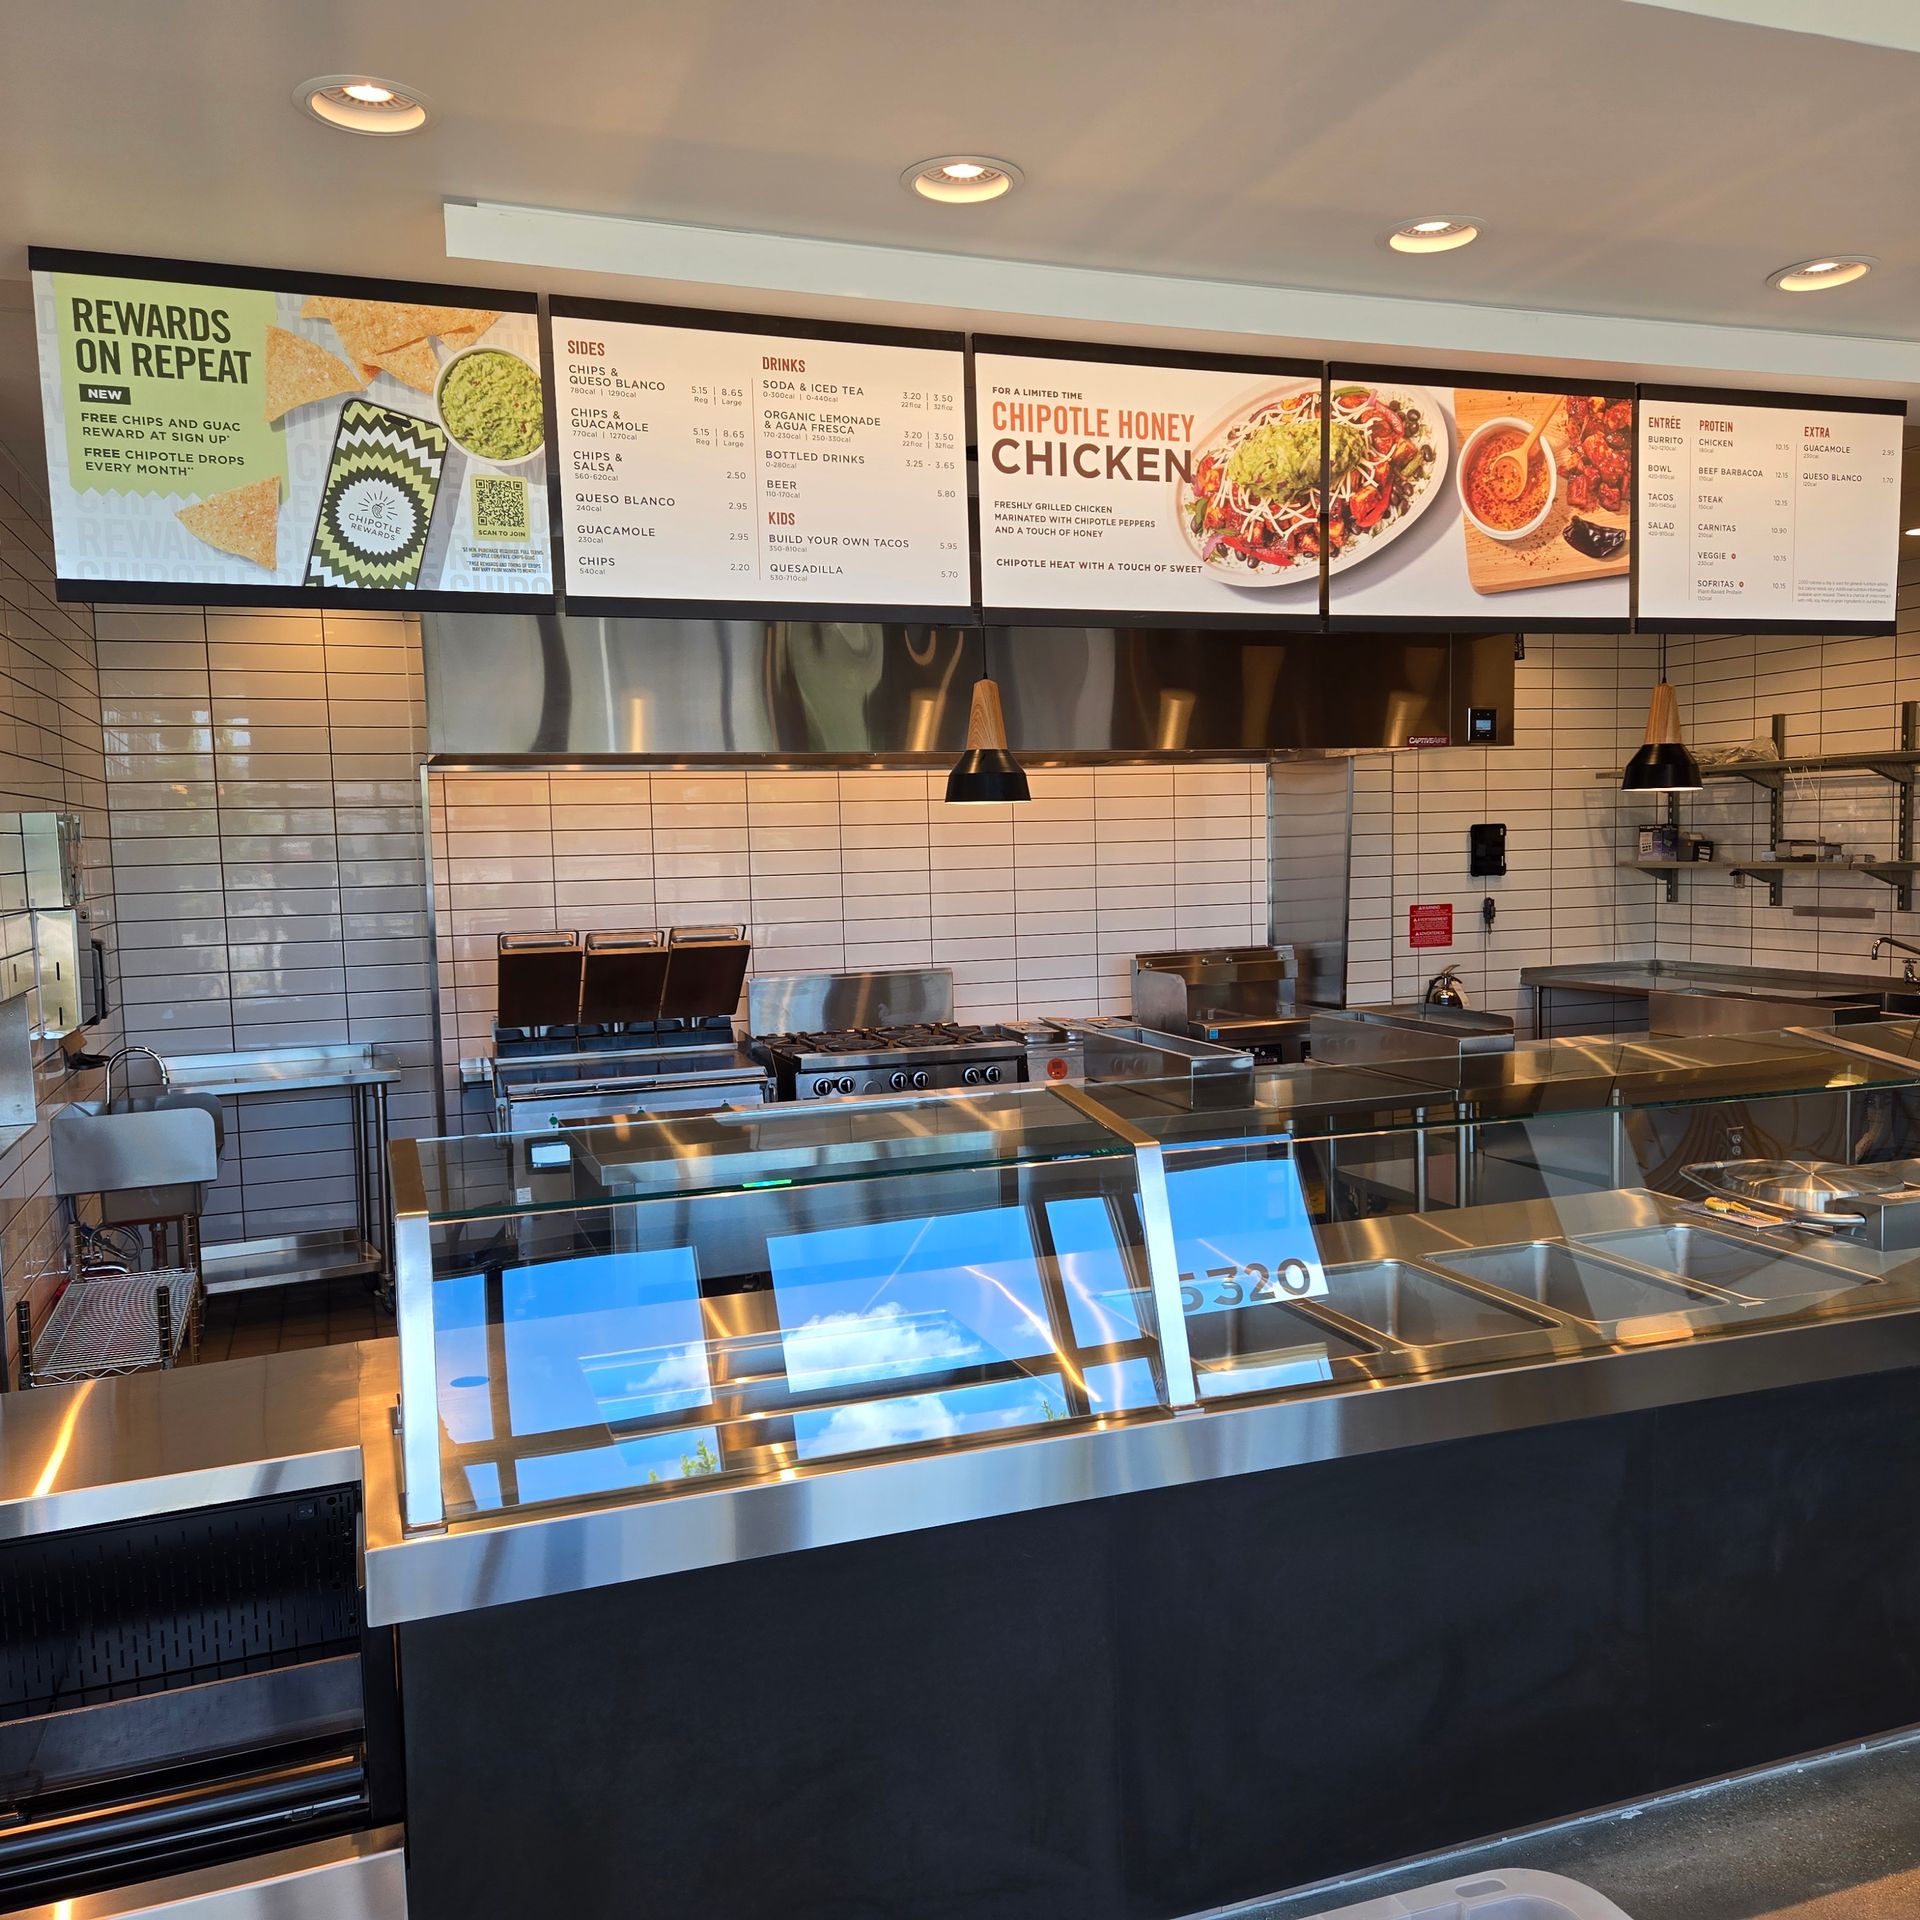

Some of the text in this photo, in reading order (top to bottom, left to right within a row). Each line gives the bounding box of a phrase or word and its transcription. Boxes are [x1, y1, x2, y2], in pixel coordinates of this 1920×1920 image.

[72, 297, 230, 343] REWARDS
[568, 340, 605, 356] SIDES
[76, 338, 251, 384] ON REPEAT
[762, 356, 806, 373] DRINKS
[569, 365, 618, 376] CHIPS &
[569, 376, 665, 391] QUESO BLANCO
[763, 380, 864, 396] SODA & ICED TEA
[88, 388, 122, 400] NEW
[692, 386, 743, 397] 5.15 8.65
[903, 392, 953, 402] 3.20 3.50
[992, 387, 1010, 395] FOR
[1023, 389, 1058, 398] LIMITED
[1061, 391, 1083, 400] TIME
[571, 408, 620, 419] CHIPS &
[764, 410, 881, 426] ORGANIC LEMONADE
[81, 413, 240, 432] FREE CHIPS AND GUAC
[572, 419, 648, 432] GUACAMOLE
[764, 421, 854, 434] & AGUA FRESCA
[992, 401, 1194, 442] CHIPOTLE HONEY
[1649, 416, 1681, 429] ENTRÉE
[1700, 420, 1733, 432] PROTEIN
[83, 427, 144, 439] REWARD
[150, 432, 166, 440] AT
[172, 433, 204, 443] SIGN
[724, 430, 745, 438] 8.65
[764, 432, 851, 443] 170-230cal 250-330cal
[1804, 426, 1830, 438] EXTRA
[1648, 436, 1683, 444] BURRITO
[1699, 439, 1733, 447] CHICKEN
[1804, 445, 1850, 453] GUACAMOLE
[84, 448, 245, 465] FREE CHIPOTLE DROPS
[574, 450, 622, 462] CHIPS &
[766, 450, 865, 464] BOTTLED DRINKS
[991, 438, 1193, 484] CHICKEN
[86, 462, 131, 472] EVERY
[574, 462, 614, 472] SALSA
[906, 460, 954, 470] 3.25 3.65
[1721, 468, 1763, 477] BARBACOA
[766, 480, 797, 490] BEER
[575, 493, 675, 507] QUESO BLANCO
[1648, 493, 1673, 501] TACOS
[995, 501, 1113, 514] FRESHLY GRILLED CHICKEN
[348, 513, 401, 534] CHIPOTLE
[768, 512, 795, 526] KIDS
[995, 513, 1156, 528] MARINATED WITH CHIPOTLE PEPPERS
[351, 523, 395, 540] REWARDS
[577, 525, 655, 536] GUACAMOLE
[995, 526, 1014, 534] AND
[1026, 527, 1056, 536] TOUCH
[1073, 530, 1103, 538] HONEY
[769, 535, 909, 548] BUILD YOUR OWN TACOS
[579, 556, 615, 566] CHIPS
[996, 558, 1046, 568] CHIPOTLE
[1050, 561, 1075, 569] HEAT
[1079, 562, 1104, 570] WITH
[1118, 563, 1151, 572] TOUCH
[1170, 565, 1203, 573] SWEET
[770, 563, 844, 574] QUESADILLA
